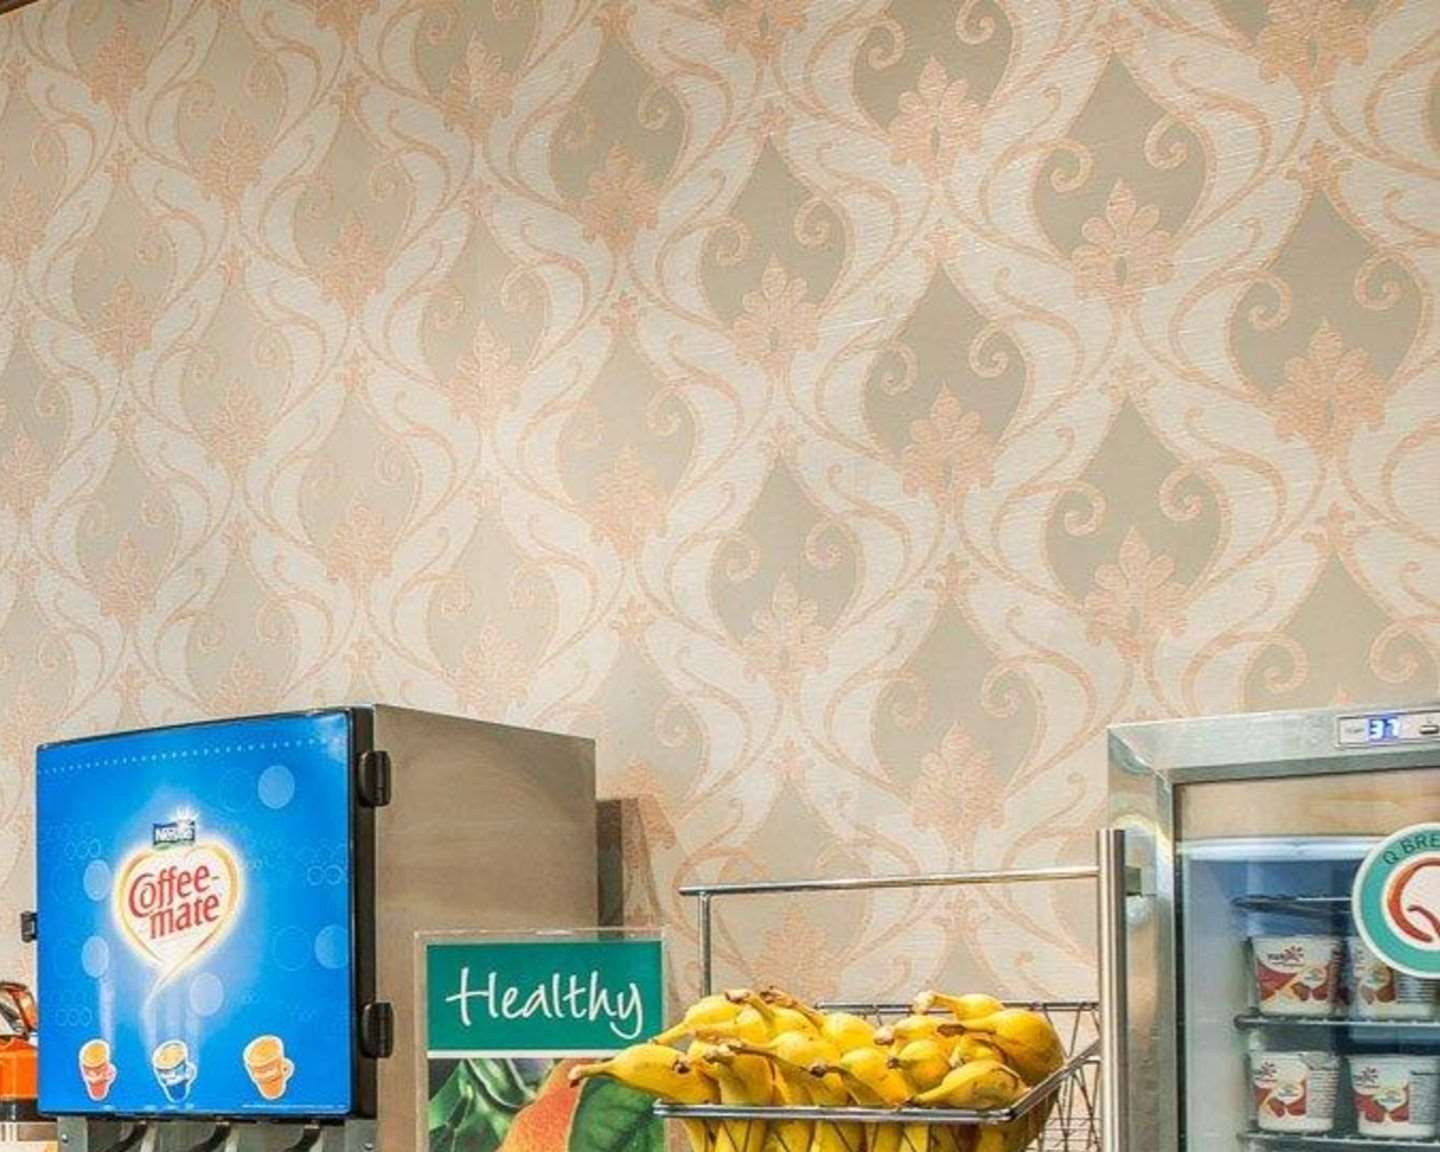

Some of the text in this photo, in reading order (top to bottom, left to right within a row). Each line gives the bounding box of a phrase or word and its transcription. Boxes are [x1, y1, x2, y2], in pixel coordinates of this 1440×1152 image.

[1382, 850, 1400, 866] Q
[148, 894, 219, 939] mate
[446, 966, 643, 1040] Healthy
